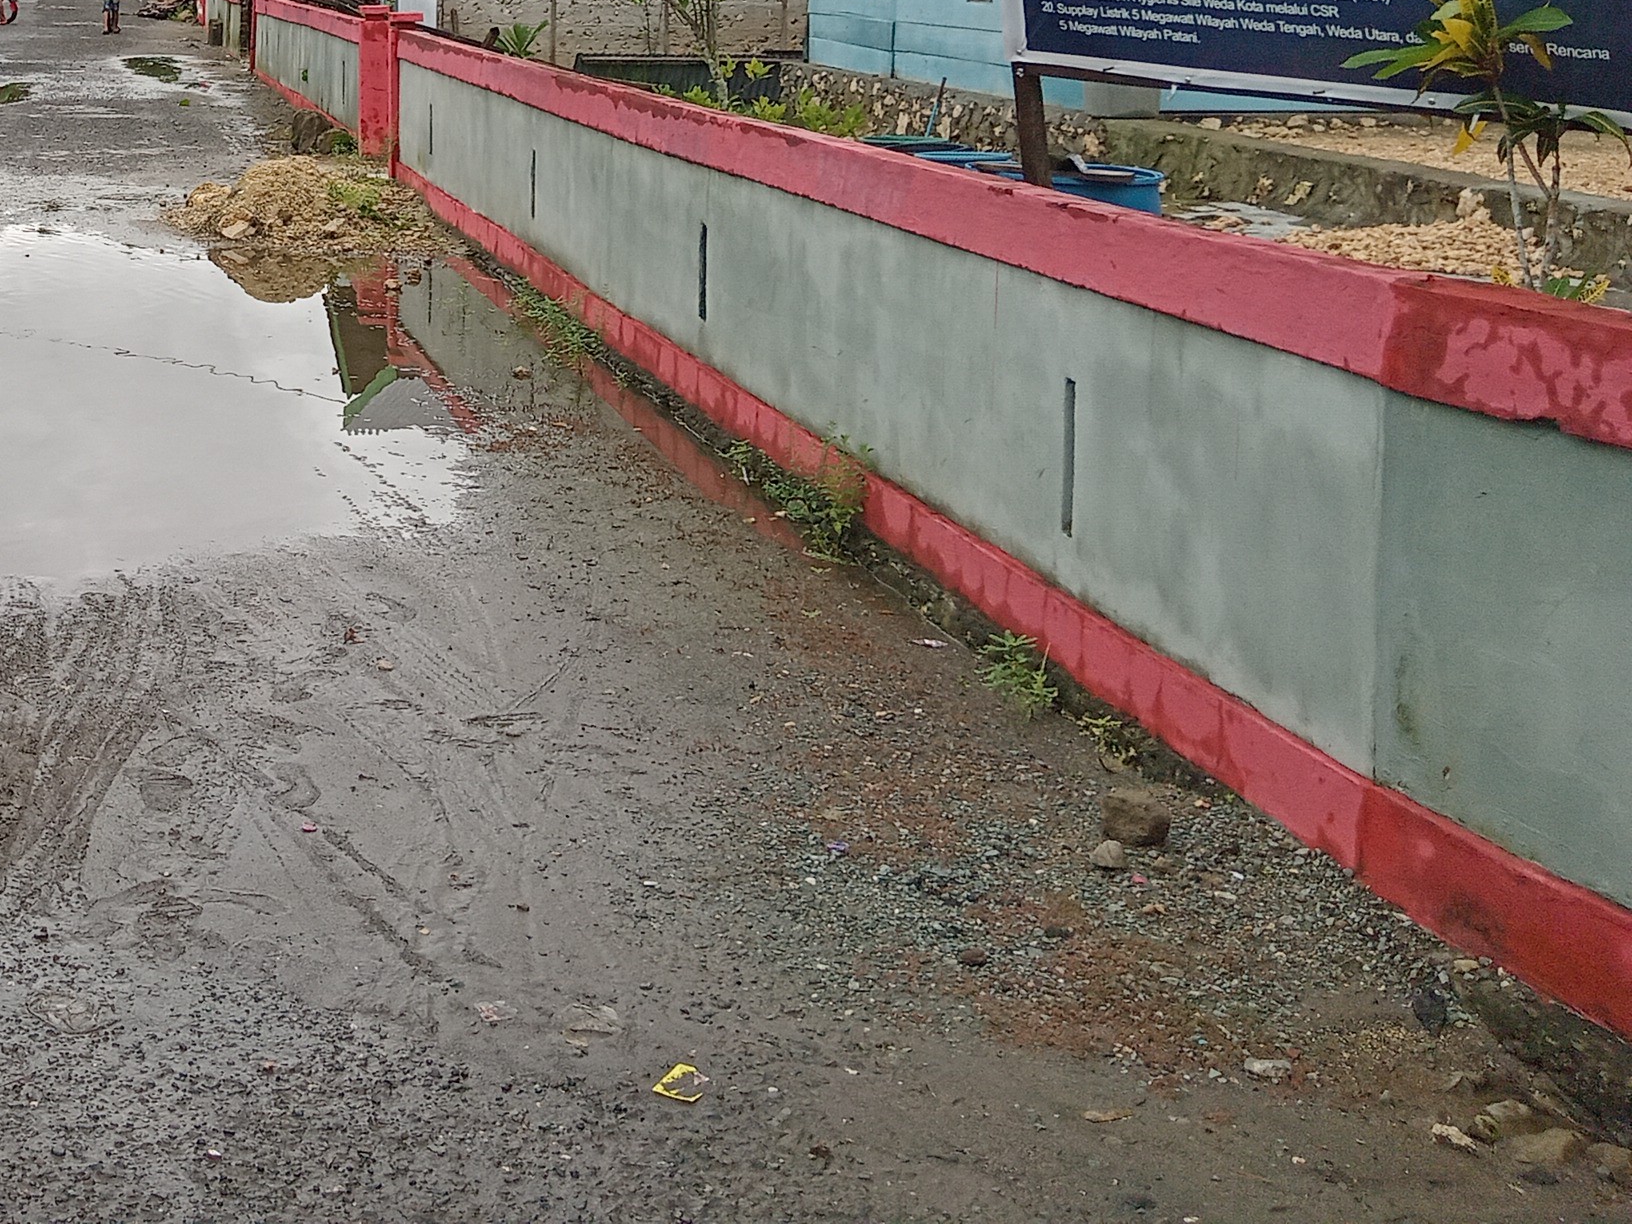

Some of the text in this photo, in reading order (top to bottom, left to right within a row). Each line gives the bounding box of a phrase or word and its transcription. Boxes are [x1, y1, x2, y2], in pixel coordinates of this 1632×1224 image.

[1235, 0, 1339, 18] Kota melalui CSR
[1239, 17, 1611, 61] Weda Weda Utara, Rencana
